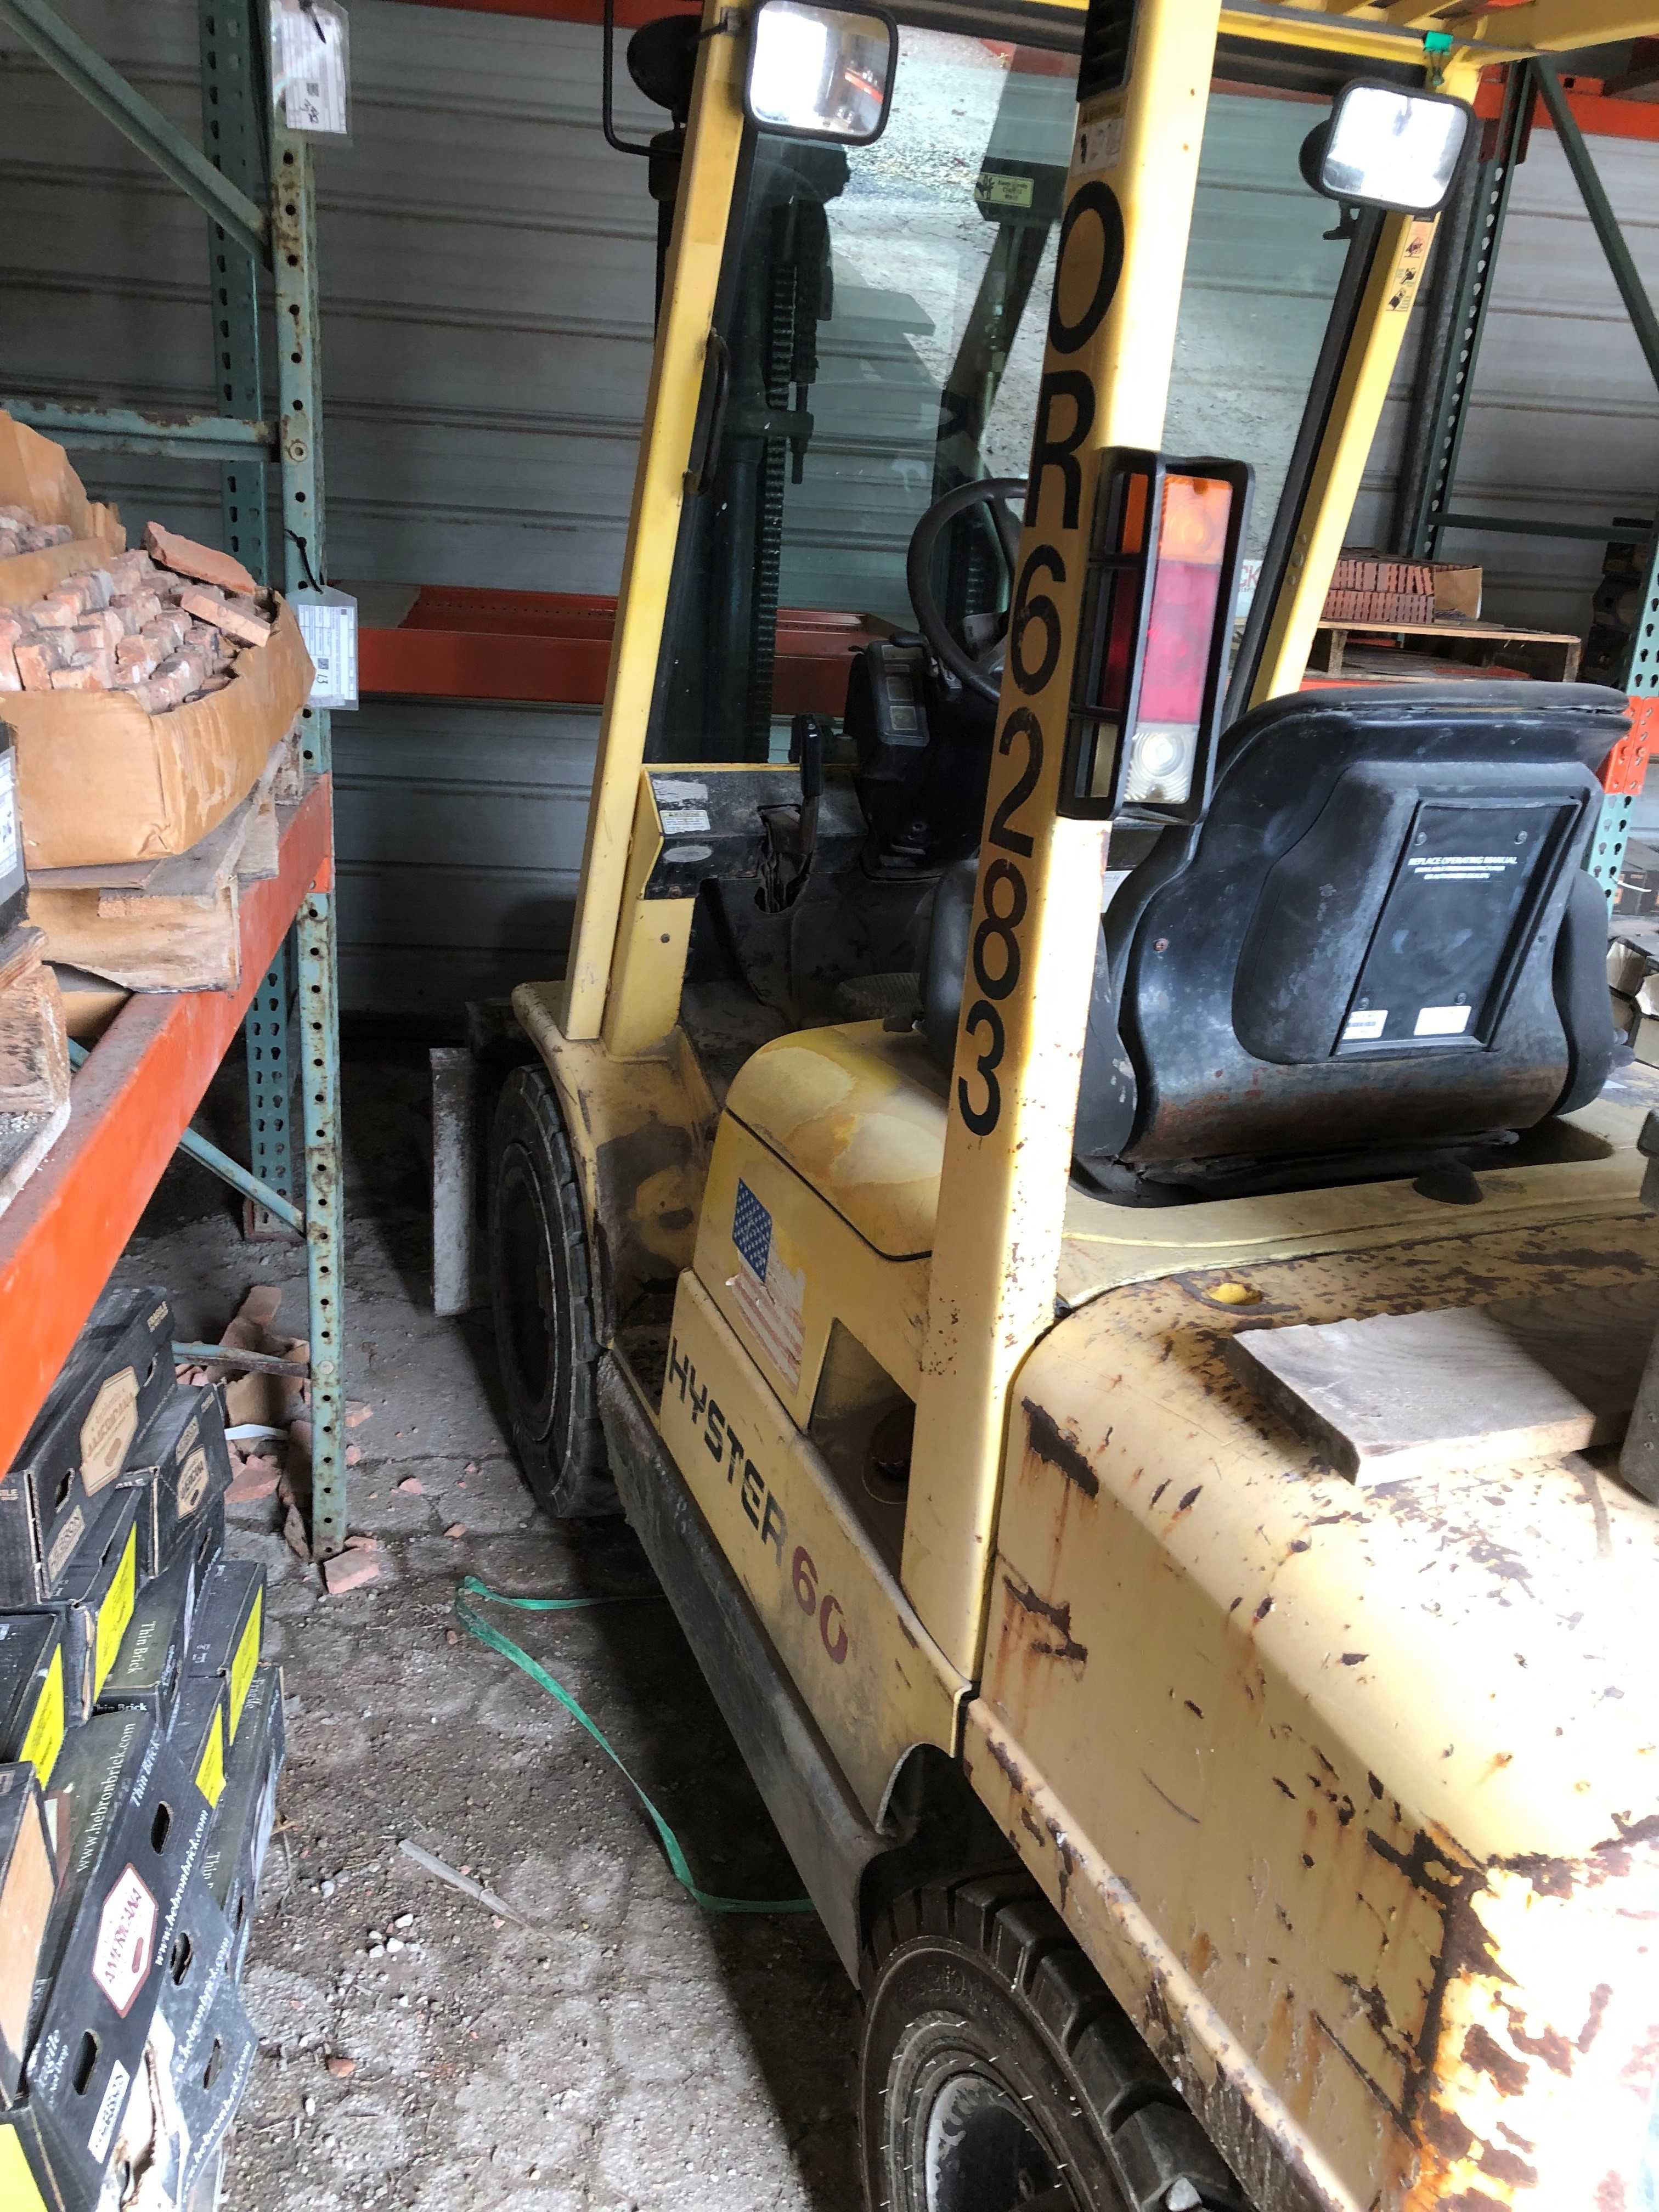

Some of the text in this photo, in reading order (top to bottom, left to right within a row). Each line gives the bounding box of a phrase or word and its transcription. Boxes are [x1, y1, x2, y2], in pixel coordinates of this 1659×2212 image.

[669, 1336, 787, 1567] HYSTER
[127, 1621, 156, 1674] Thin Brick
[118, 1703, 147, 1711] Brick
[77, 1723, 136, 1872] www.hebronbrick.com
[128, 1774, 148, 1807] Thin
[155, 1809, 208, 1966] www.hebronbrick.com
[202, 1852, 220, 1880] Thin
